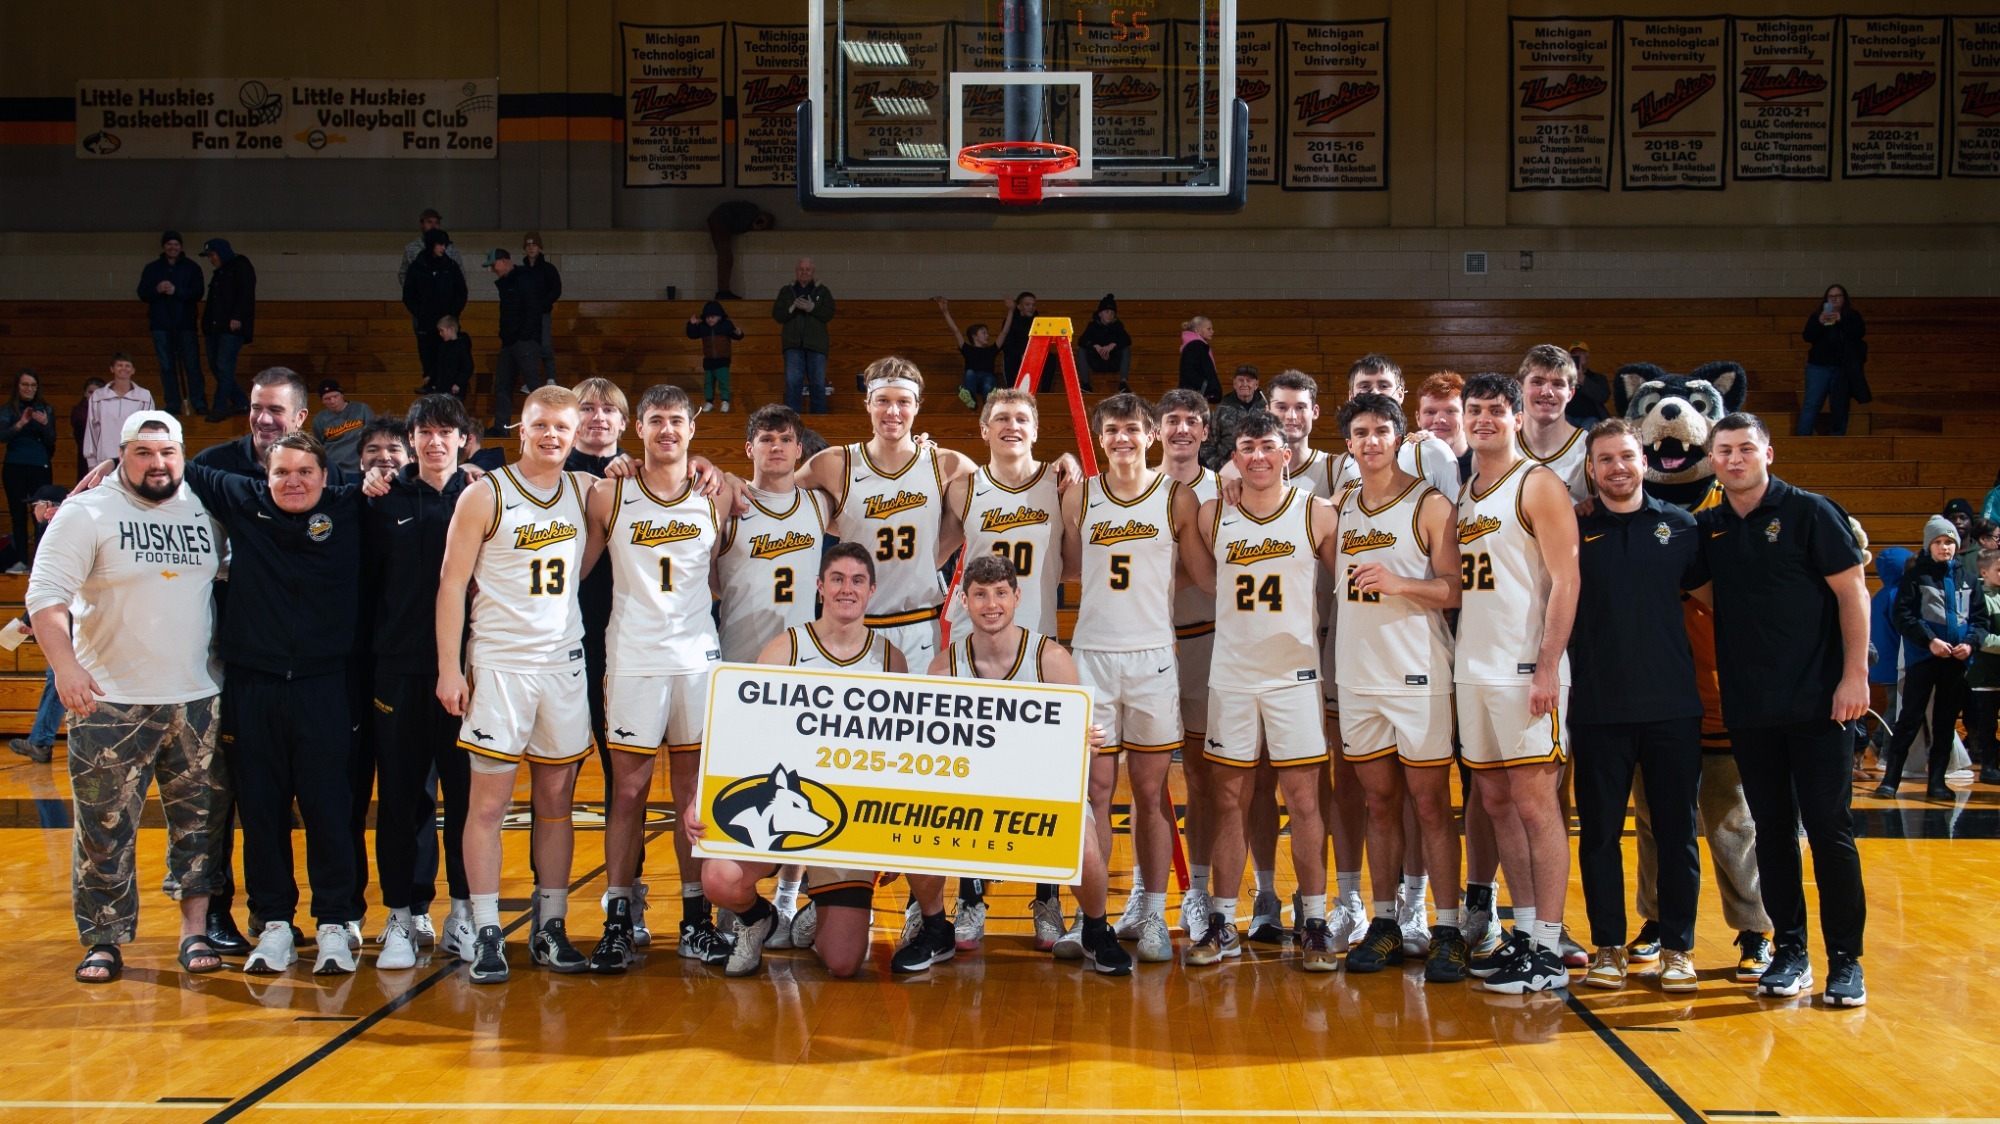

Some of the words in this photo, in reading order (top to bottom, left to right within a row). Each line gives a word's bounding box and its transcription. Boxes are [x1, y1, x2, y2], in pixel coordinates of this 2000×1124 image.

[1535, 28, 1592, 39] Michigan
[1645, 25, 1703, 36] Michigan
[1756, 22, 1814, 34] Michigan
[1867, 22, 1924, 34] Michigan
[645, 33, 700, 47] Michigan
[867, 30, 922, 43] Michigan
[1307, 28, 1364, 41] Michigan
[1740, 32, 1830, 44] Technological
[1519, 40, 1608, 51] Technological
[1630, 37, 1719, 48] Technological
[1850, 35, 1941, 47] Technological
[1073, 42, 1160, 55] Technological
[1292, 41, 1379, 54] Technological
[1753, 45, 1815, 59] University
[632, 48, 715, 62] Technological
[1531, 52, 1593, 64] University
[1642, 52, 1705, 63] University
[1862, 49, 1926, 60] University
[756, 56, 808, 67] Universit
[1086, 56, 1147, 67] University
[1304, 55, 1367, 68] University
[643, 65, 704, 79] University
[1740, 66, 1828, 99] Huskies
[81, 88, 133, 106] Little
[139, 88, 215, 106] Huskies
[292, 87, 344, 105] Little
[350, 87, 426, 106] Huskies
[1519, 73, 1607, 110] Huskies
[1851, 70, 1936, 118] Huskies
[631, 83, 717, 119] Huskies
[1293, 82, 1380, 124] Huskies
[1631, 74, 1716, 129] Huskies
[1758, 107, 1810, 117] 2020-21
[103, 110, 209, 128] Basketball
[215, 110, 261, 128] Club
[317, 109, 416, 130] Volleyball
[422, 109, 468, 128] Club
[1740, 120, 1769, 129] GLIAC
[1773, 119, 1826, 129] Conference
[868, 127, 923, 136] 2012-13
[1114, 128, 1155, 136] Basketball
[1536, 125, 1589, 135] 2017-18
[1755, 130, 1813, 141] Champions
[1868, 130, 1920, 140] 2020-21
[192, 131, 229, 149] Fan
[236, 131, 283, 149] Zone
[403, 131, 440, 149] Fan
[447, 131, 493, 149] Zone
[632, 137, 669, 145] Women's
[673, 137, 717, 145] Basketball
[744, 138, 778, 147] Regional
[1097, 137, 1136, 146] GLIAC
[1307, 141, 1364, 151] 2015-16
[1518, 136, 1544, 144] GLIAC
[1548, 136, 1571, 144] North
[1574, 136, 1605, 144] Division
[1960, 139, 1988, 148] NCAA
[1540, 145, 1585, 154] Champions
[1740, 142, 1770, 151] GLIAC
[1773, 142, 1826, 151] Tournament
[1852, 142, 1880, 150] NCAA
[1885, 142, 1924, 151] Division
[629, 154, 648, 162] North
[1312, 153, 1357, 163] GLIAC
[1523, 157, 1551, 165] NCAA
[1554, 157, 1592, 165] Division
[1651, 152, 1697, 161] GLIAC
[1754, 152, 1812, 163] Champions
[1851, 152, 1884, 162] Regional
[1887, 152, 1934, 161] Semifinalist
[1958, 150, 1991, 162] Regional
[648, 163, 701, 171] Champions
[744, 164, 780, 172] Women's
[1294, 164, 1329, 172] Women's
[1333, 164, 1376, 172] Basketball
[1519, 166, 1550, 175] Regional
[1632, 164, 1669, 172] Women's
[1672, 163, 1716, 172] Basketball
[1740, 163, 1779, 174] Women's
[1781, 164, 1826, 174] Basketball
[1851, 162, 1886, 171] Women's
[1890, 162, 1934, 171] Basketball
[1957, 161, 1998, 172] Women's
[661, 171, 687, 180] 31-3
[1341, 175, 1377, 184] Champions
[1521, 176, 1555, 184] Women's
[1630, 174, 1649, 182] North
[1651, 174, 1677, 182] Division
[1681, 173, 1716, 184] Champions
[324, 419, 364, 440] Huskies
[864, 491, 928, 520] Huskies
[981, 506, 1049, 533] Huskies
[119, 520, 211, 554] HUSKIES
[513, 520, 577, 550] Huskies
[630, 519, 701, 548] Huskies
[1089, 519, 1159, 547] Huskies
[749, 530, 815, 560] Huskies
[876, 525, 916, 562] 33
[1340, 528, 1396, 557] Huskies
[135, 550, 202, 566] FOOTBALL
[1226, 538, 1296, 566] Huskies
[528, 557, 565, 596] 13
[659, 556, 673, 593] 1
[1109, 554, 1131, 591] 5
[1461, 552, 1495, 592] 32
[773, 566, 795, 604] 2
[1235, 573, 1283, 613] 24
[738, 680, 834, 709] GLIAC
[843, 687, 1062, 726] CONFERENCE
[796, 712, 996, 749] CHAMPIONS
[815, 747, 970, 778] 2025-2026
[852, 800, 984, 833] MICHIGAN
[993, 809, 1058, 838] TECH
[892, 832, 1015, 851] HUSKIES
